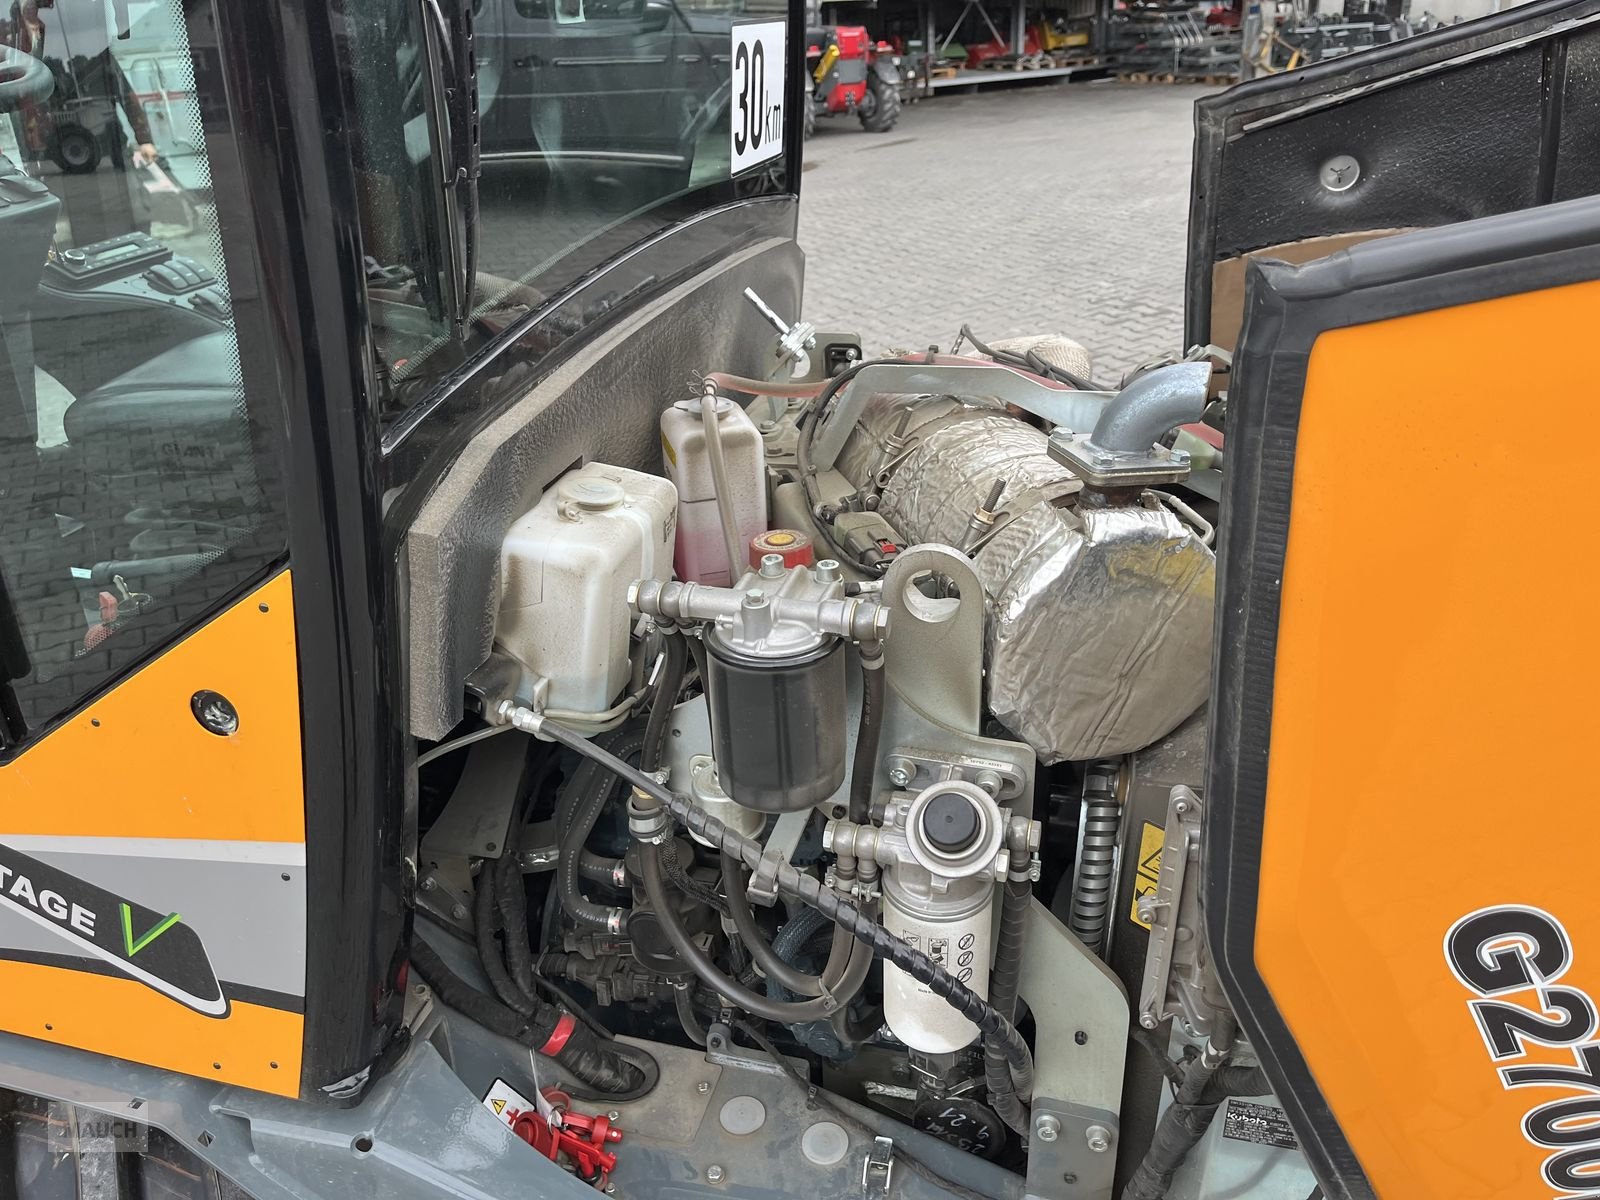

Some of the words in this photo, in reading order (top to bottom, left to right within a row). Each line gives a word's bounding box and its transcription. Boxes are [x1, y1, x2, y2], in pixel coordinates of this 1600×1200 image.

[734, 39, 764, 156] 30
[764, 90, 781, 144] km
[119, 902, 182, 957] V
[1443, 904, 1600, 1200] G2700
[1227, 1112, 1268, 1126] Kubota
